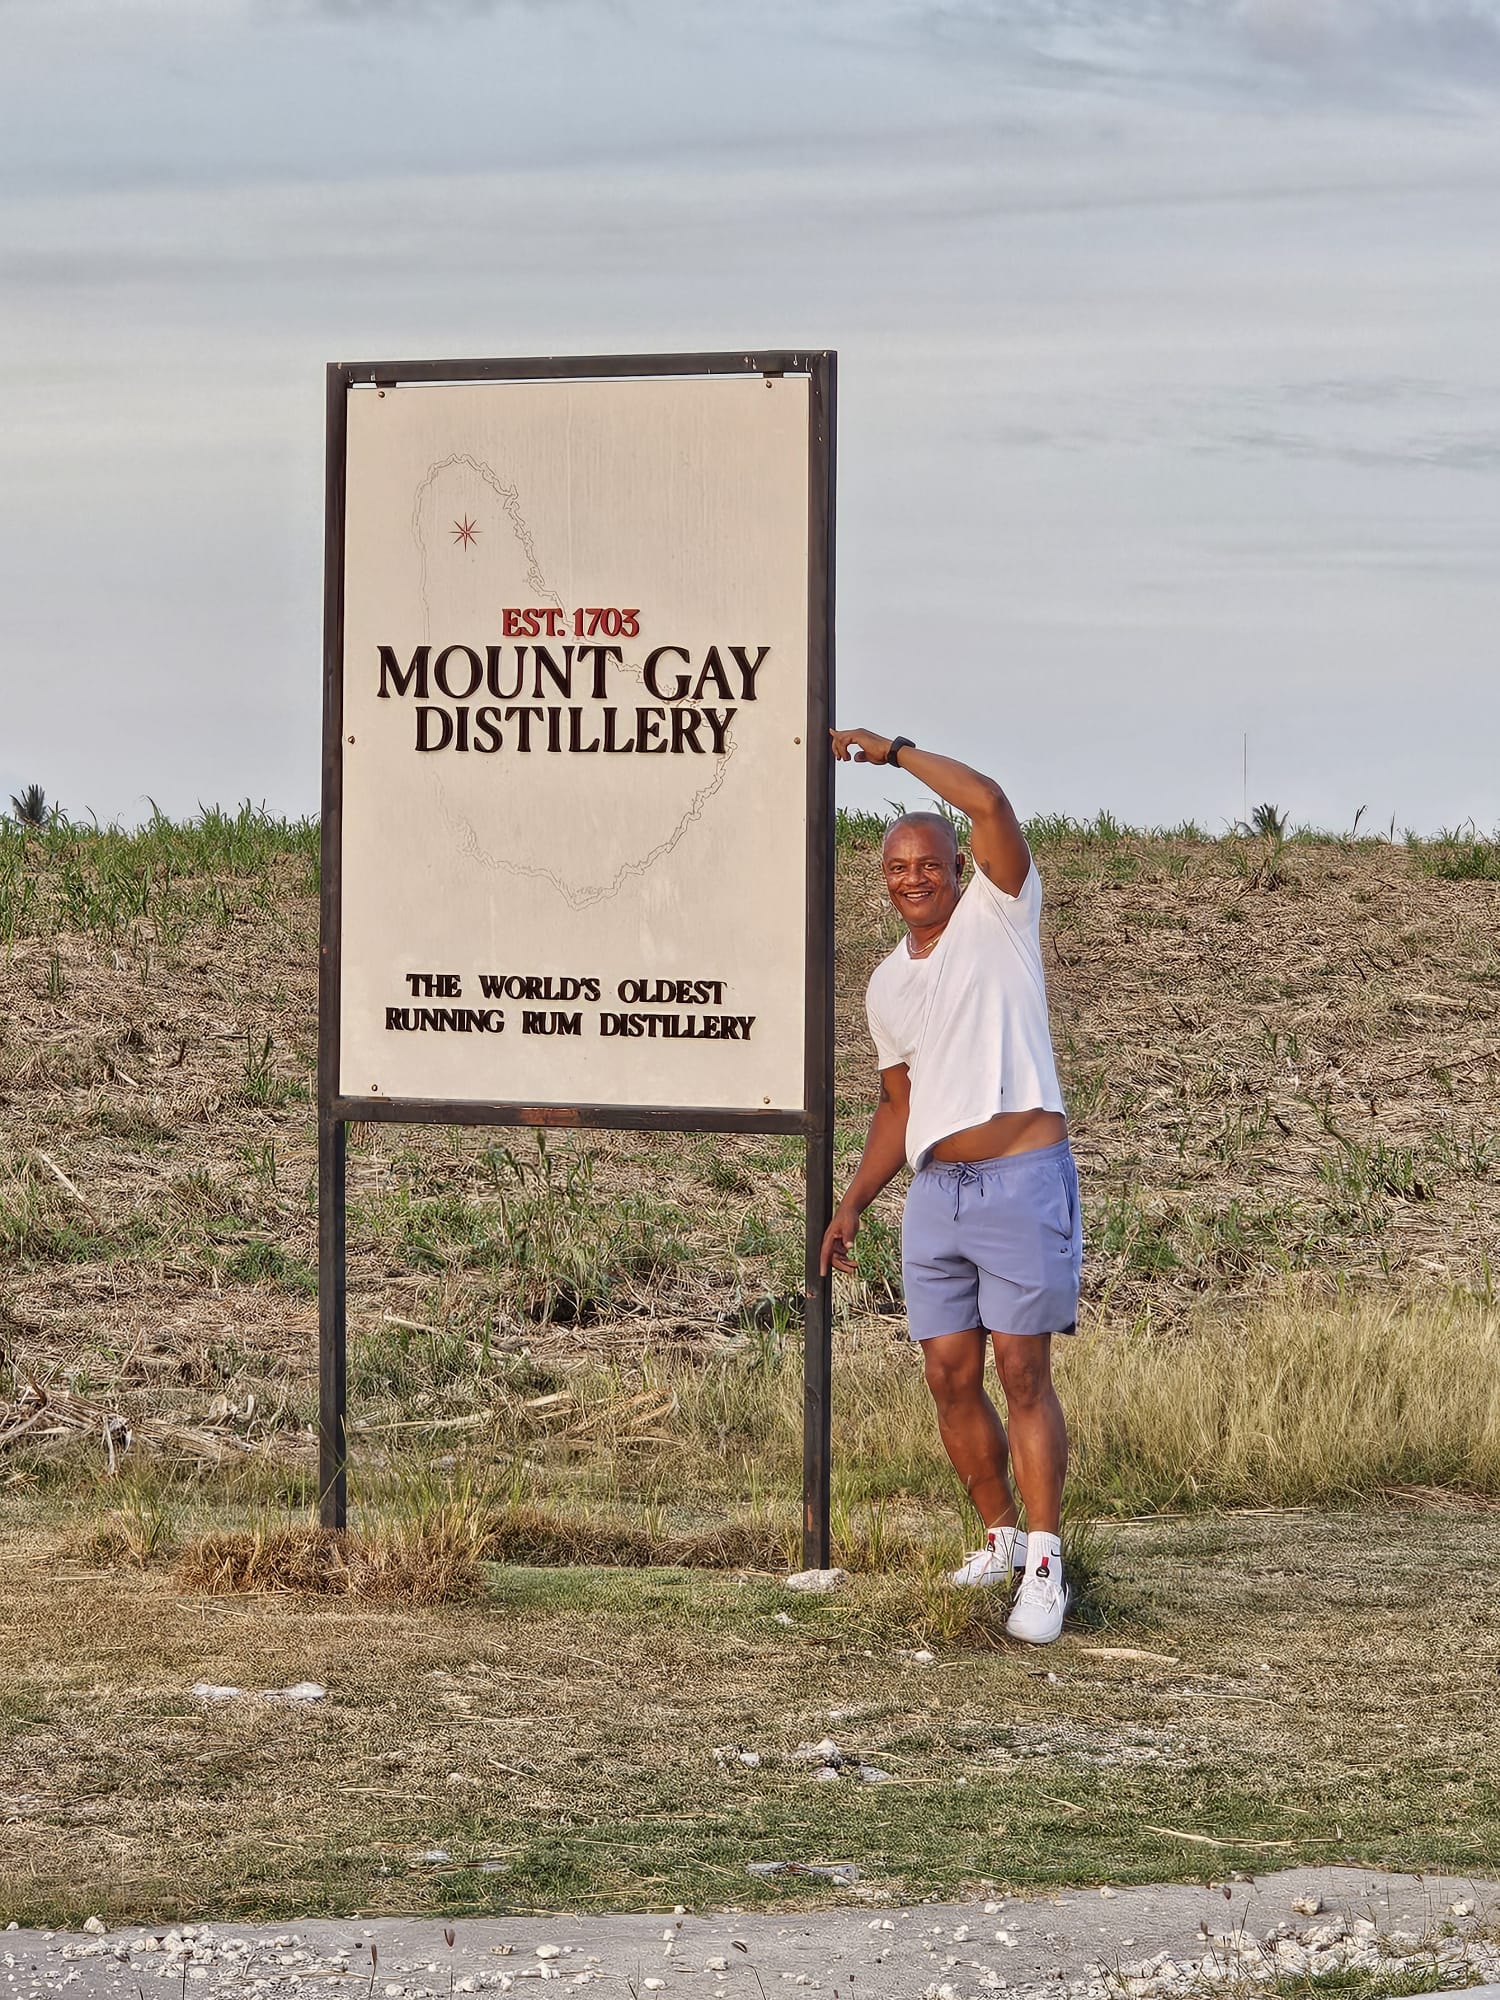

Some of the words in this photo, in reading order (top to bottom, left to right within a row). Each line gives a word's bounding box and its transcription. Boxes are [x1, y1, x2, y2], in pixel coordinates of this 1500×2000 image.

[502, 607, 566, 637] EST.
[573, 607, 641, 638] 1703
[376, 644, 623, 699] MOUNT
[643, 645, 771, 701] GAY
[414, 706, 738, 754] DISTILLERY
[405, 973, 463, 998] THE
[478, 974, 601, 1001] WORLD'S
[617, 979, 728, 1005] OLDEST
[385, 1007, 505, 1034] RUNNING
[522, 1010, 583, 1036] RUM
[599, 1012, 757, 1041] DISTILLERY
